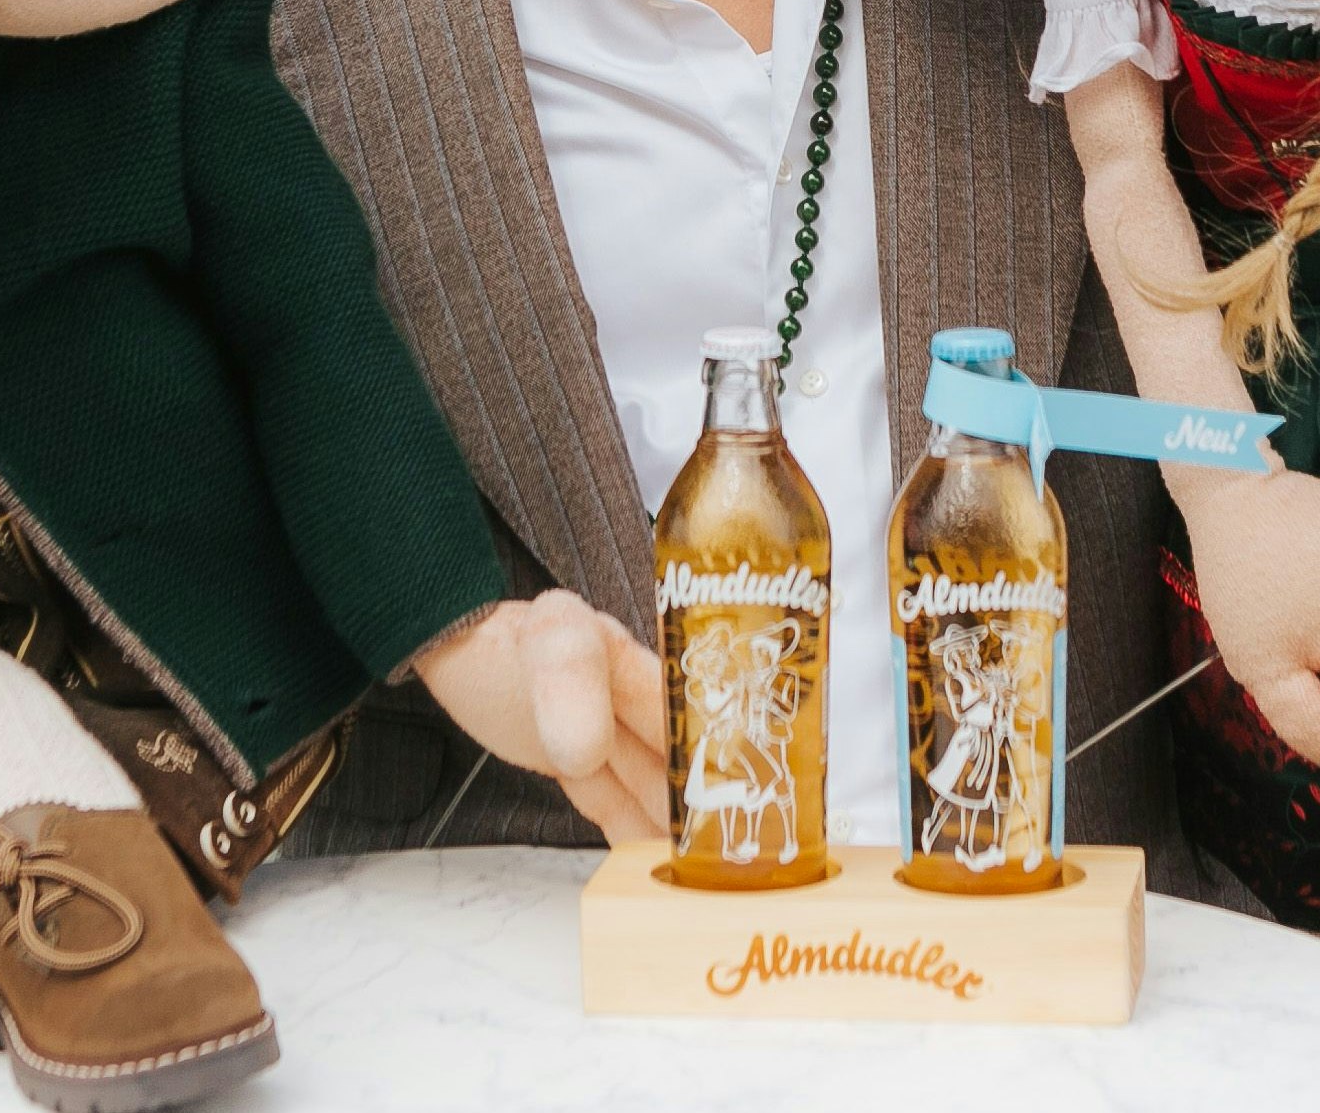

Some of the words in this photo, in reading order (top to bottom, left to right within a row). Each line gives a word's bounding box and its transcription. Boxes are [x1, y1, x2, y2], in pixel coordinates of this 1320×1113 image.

[1164, 414, 1246, 455] Neu!
[656, 560, 829, 617] Almdudler
[706, 929, 984, 999] Almdudler
